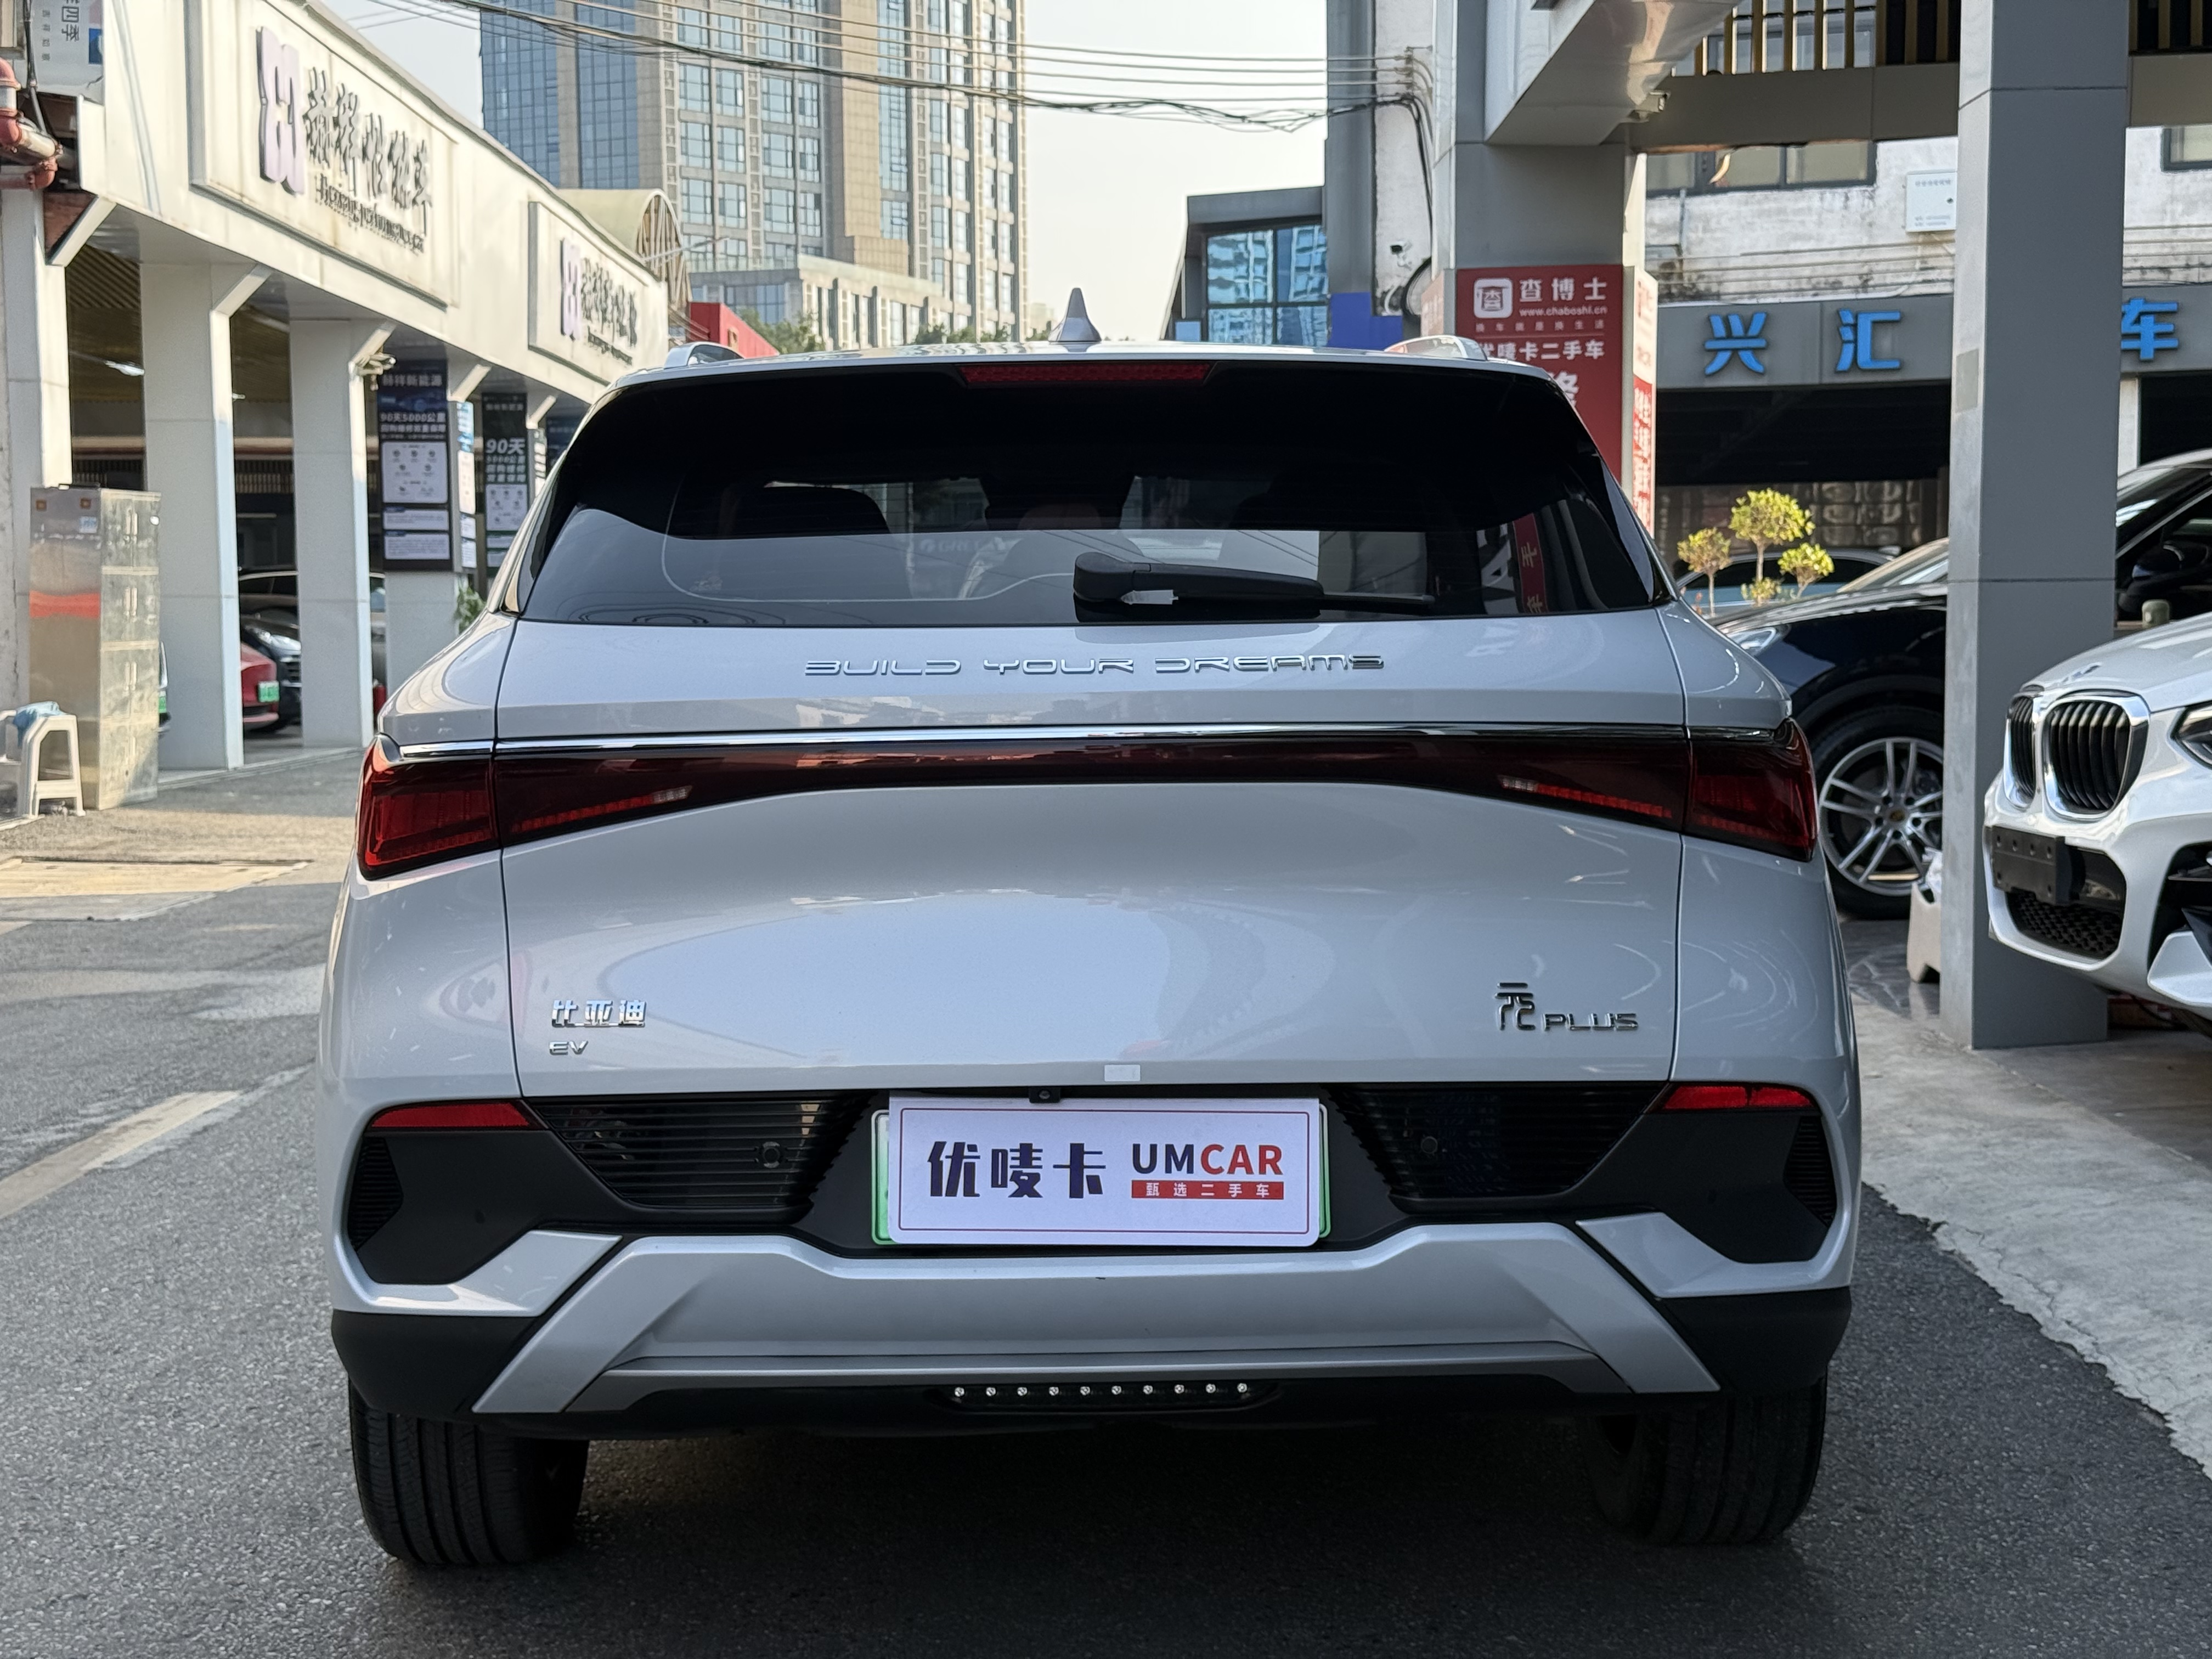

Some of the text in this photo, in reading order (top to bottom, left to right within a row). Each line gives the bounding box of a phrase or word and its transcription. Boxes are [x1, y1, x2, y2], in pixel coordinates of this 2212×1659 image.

[61, 0, 80, 42] 四季
[1519, 276, 1607, 302] 查博士
[1519, 306, 1607, 317] www.chaboshi.cn
[1704, 308, 1901, 375] 兴汇
[2121, 297, 2179, 360] 车
[486, 438, 525, 454] 90天
[805, 654, 1384, 676] BUILD YOUR DREAMS
[551, 1000, 646, 1028] 比亚迪
[1542, 1013, 1638, 1031] PLUS
[550, 1040, 588, 1055] EV
[927, 1141, 1107, 1199] 优唛卡
[1132, 1143, 1283, 1176] UMCAR
[1146, 1182, 1271, 1199] 甄选二手车
